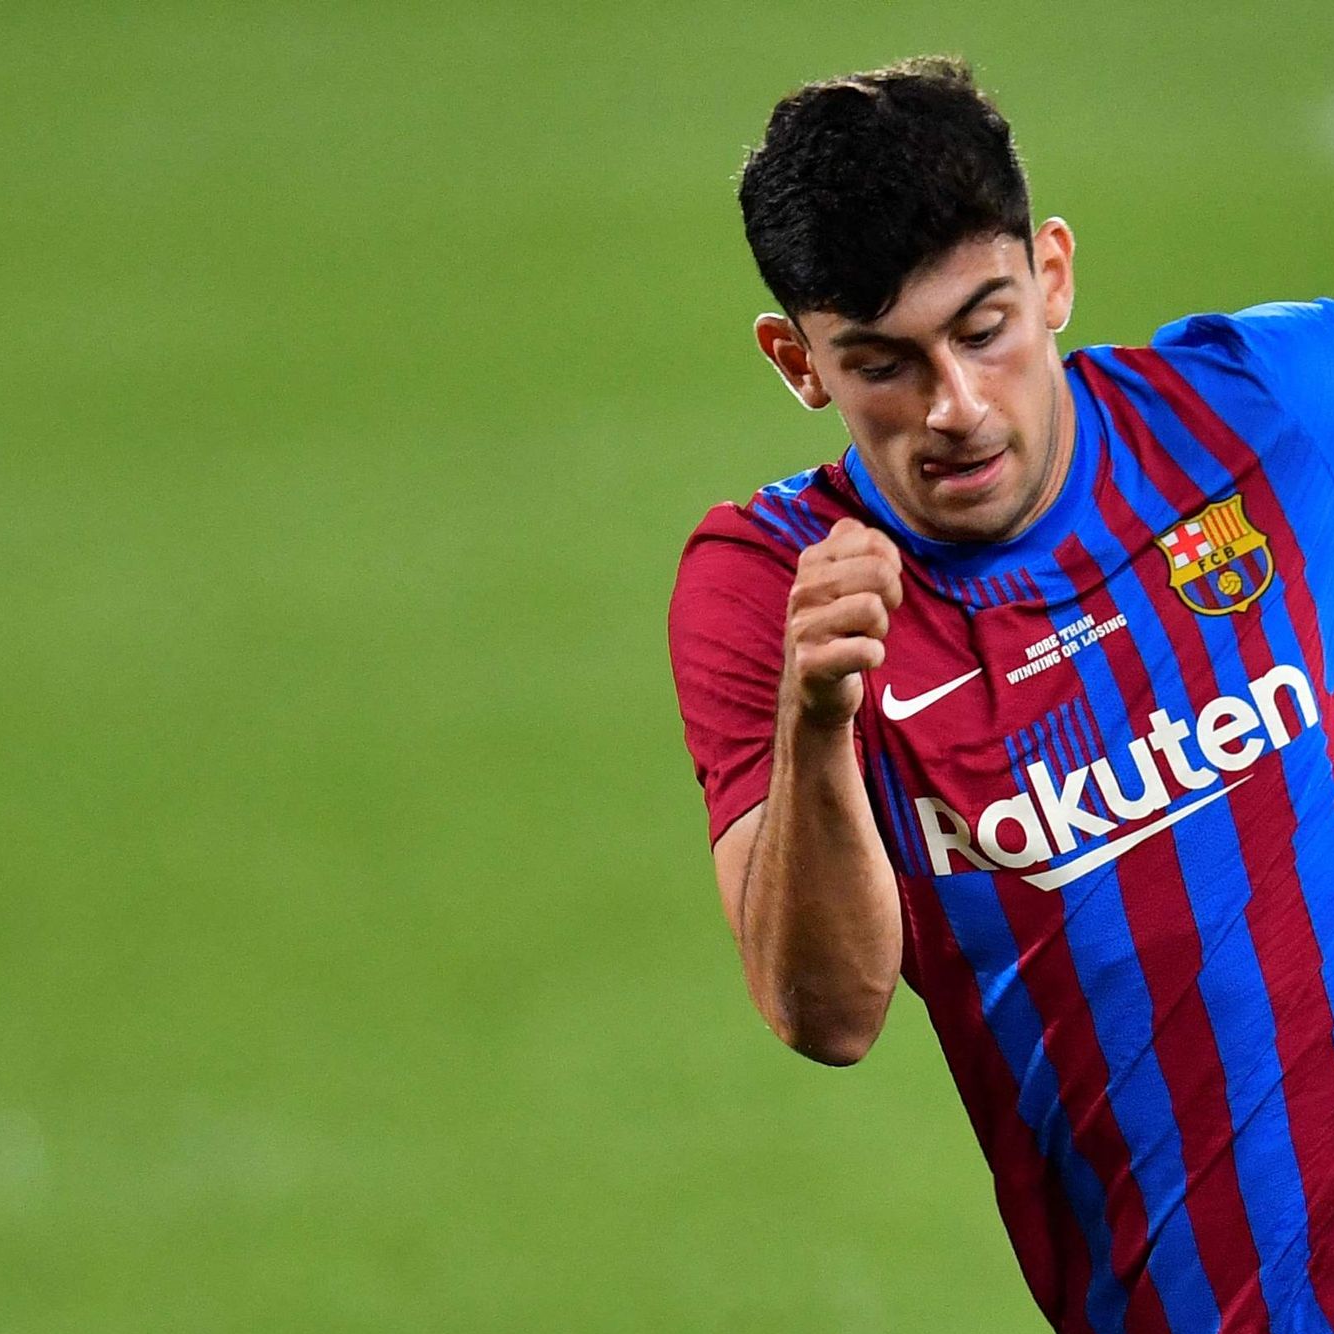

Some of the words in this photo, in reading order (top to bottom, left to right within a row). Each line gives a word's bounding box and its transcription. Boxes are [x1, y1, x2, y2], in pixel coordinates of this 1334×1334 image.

[1198, 546, 1235, 572] FCB
[1006, 650, 1061, 685] WINNING
[1061, 641, 1080, 658] OR
[1080, 614, 1128, 647] LOSING
[1025, 634, 1060, 660] MORE
[1059, 614, 1096, 642] THAN
[914, 664, 1319, 877] Rakuten
